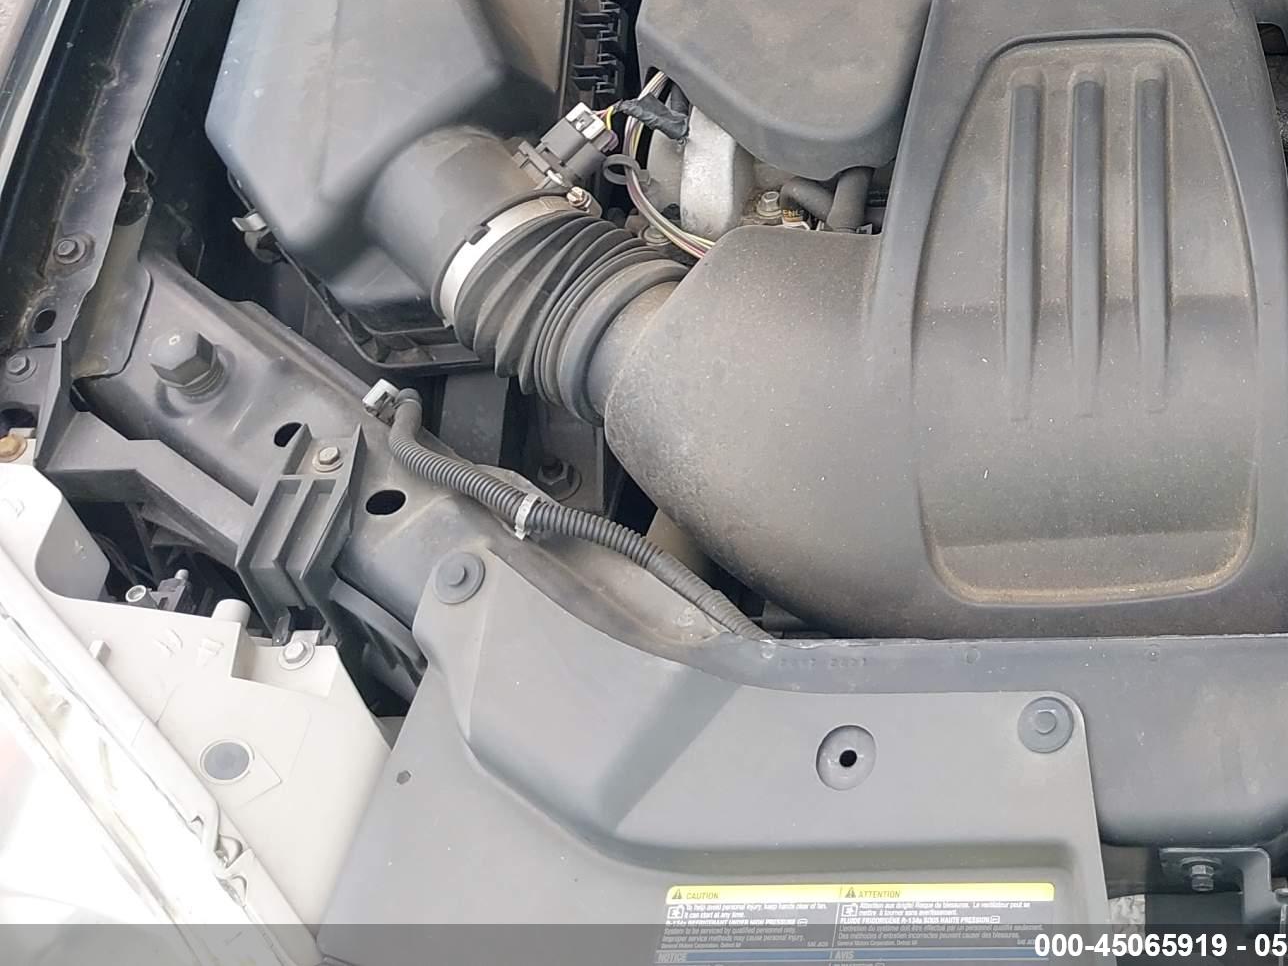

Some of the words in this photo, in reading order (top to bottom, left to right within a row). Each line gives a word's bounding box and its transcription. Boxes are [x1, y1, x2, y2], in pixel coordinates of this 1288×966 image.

[686, 890, 719, 900] CAUTION
[858, 890, 900, 898] ATTENTION
[835, 951, 855, 959] AVIS
